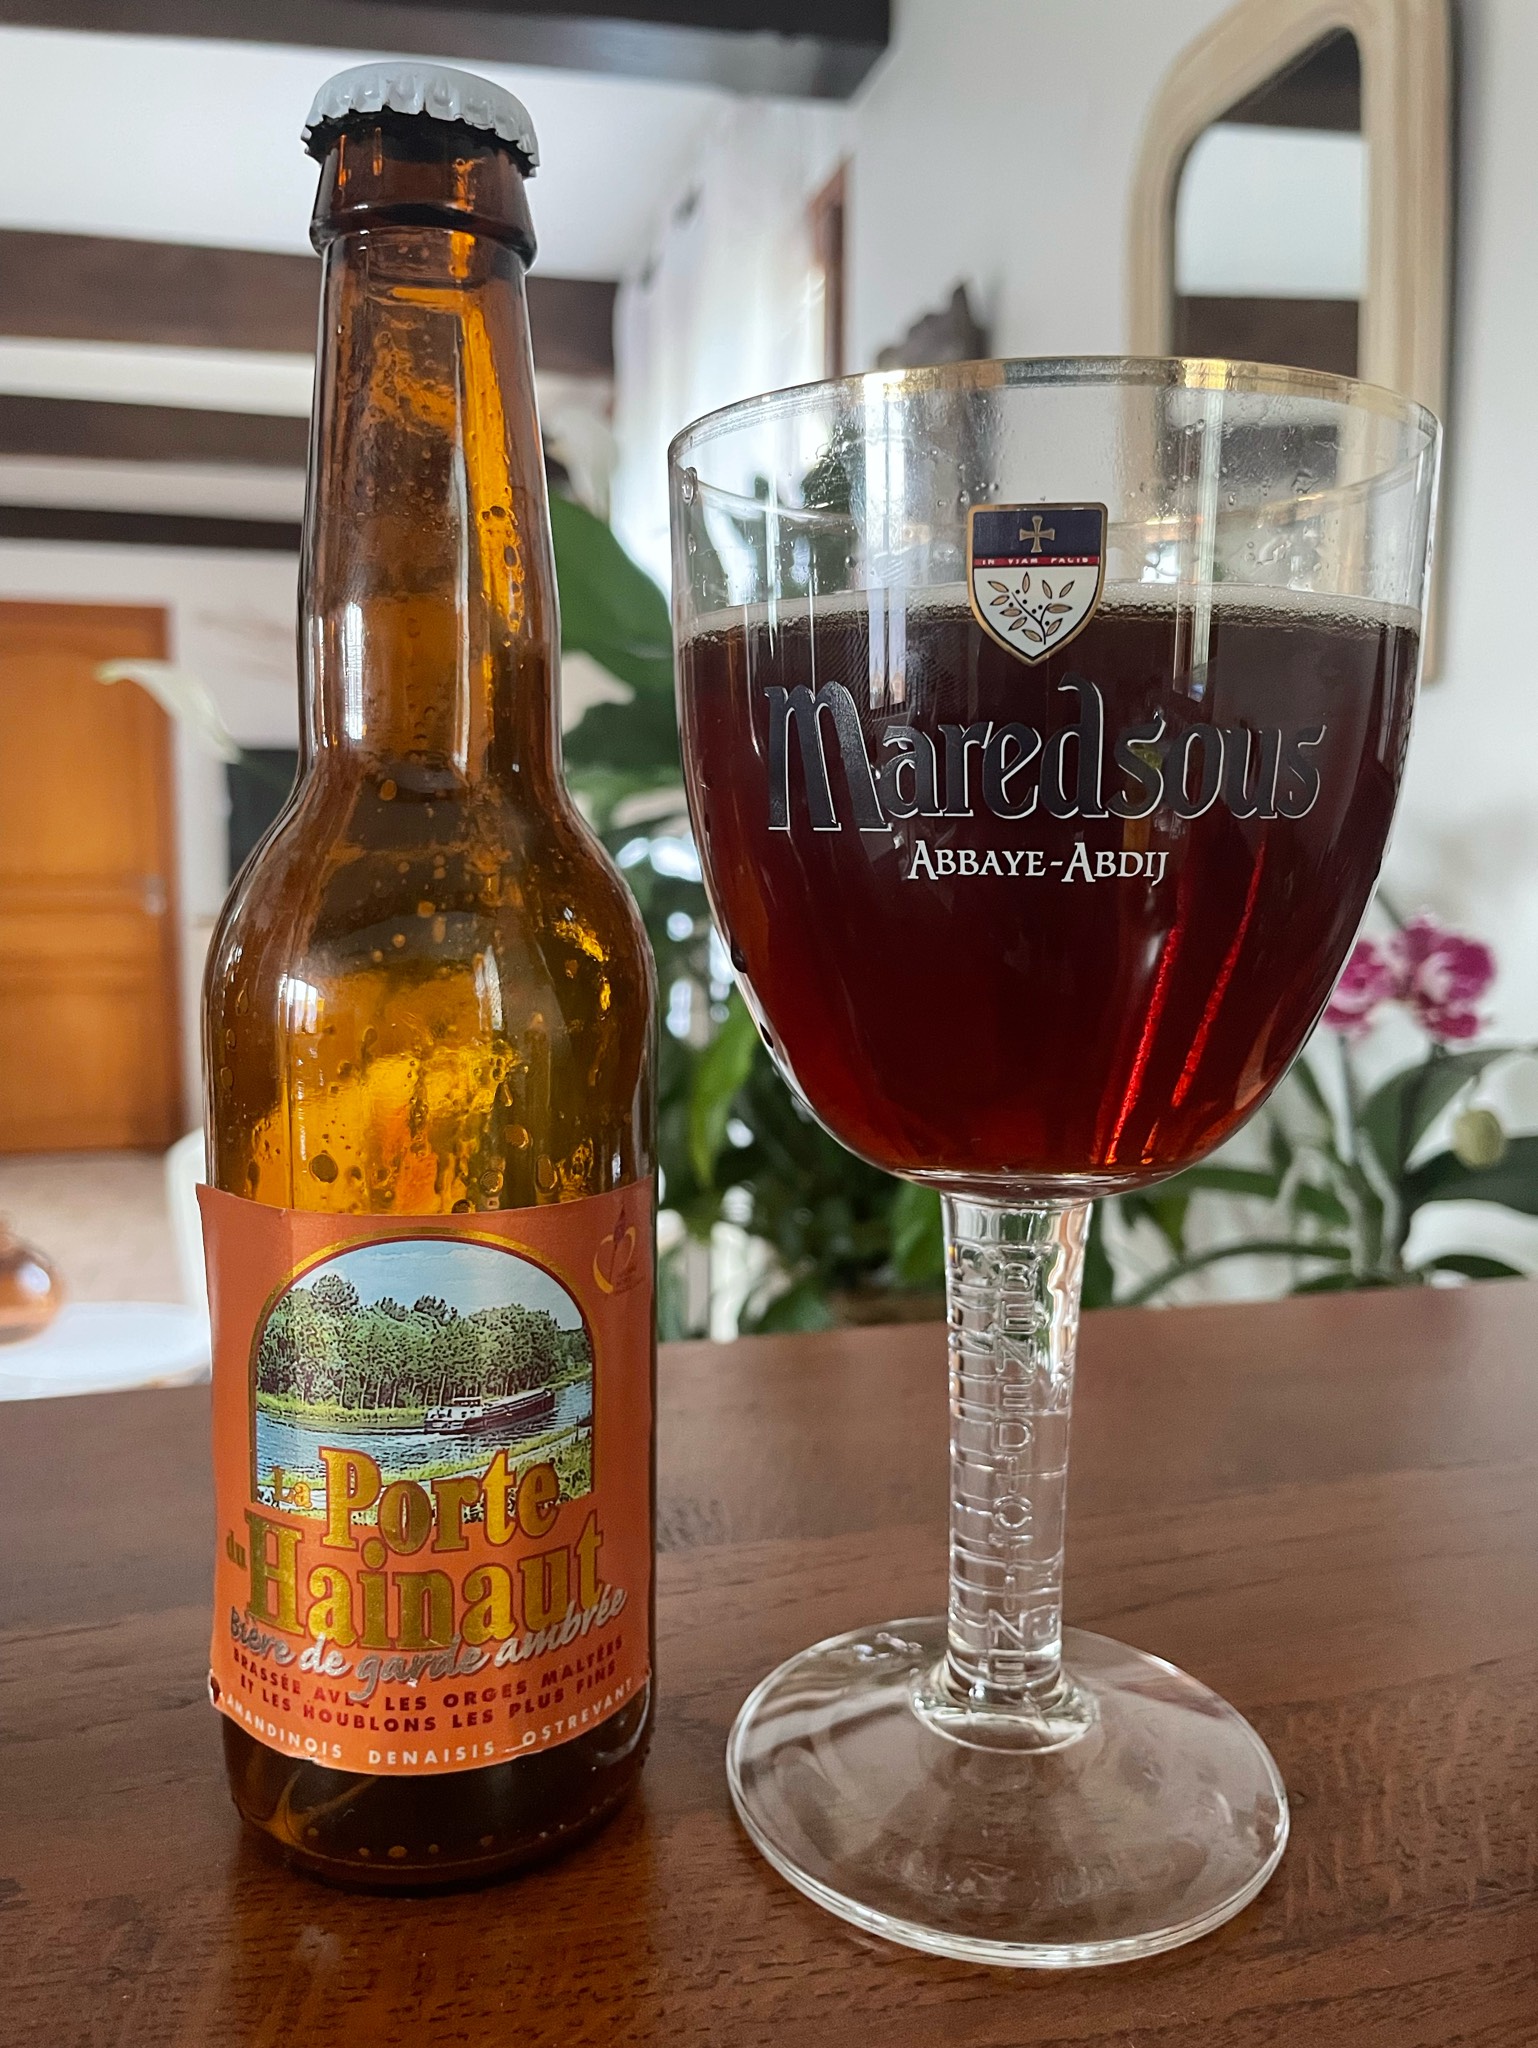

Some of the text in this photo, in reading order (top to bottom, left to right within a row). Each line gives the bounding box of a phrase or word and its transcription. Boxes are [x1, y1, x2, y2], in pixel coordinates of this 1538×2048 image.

[764, 672, 1327, 832] Maredsous
[271, 1446, 560, 1554] La Porte
[225, 1508, 604, 1651] du Hainaut
[231, 1583, 628, 1702] Bière de garde ambrée
[234, 1647, 301, 1695] BRASSÉE
[385, 1696, 427, 1711] LES
[443, 1680, 527, 1708] ORGES
[240, 1659, 616, 1732] ET LES HOUBLONS LES PLUS FINS
[368, 1741, 495, 1765] DENAISIS
[522, 1678, 633, 1746] OSTREVANT
